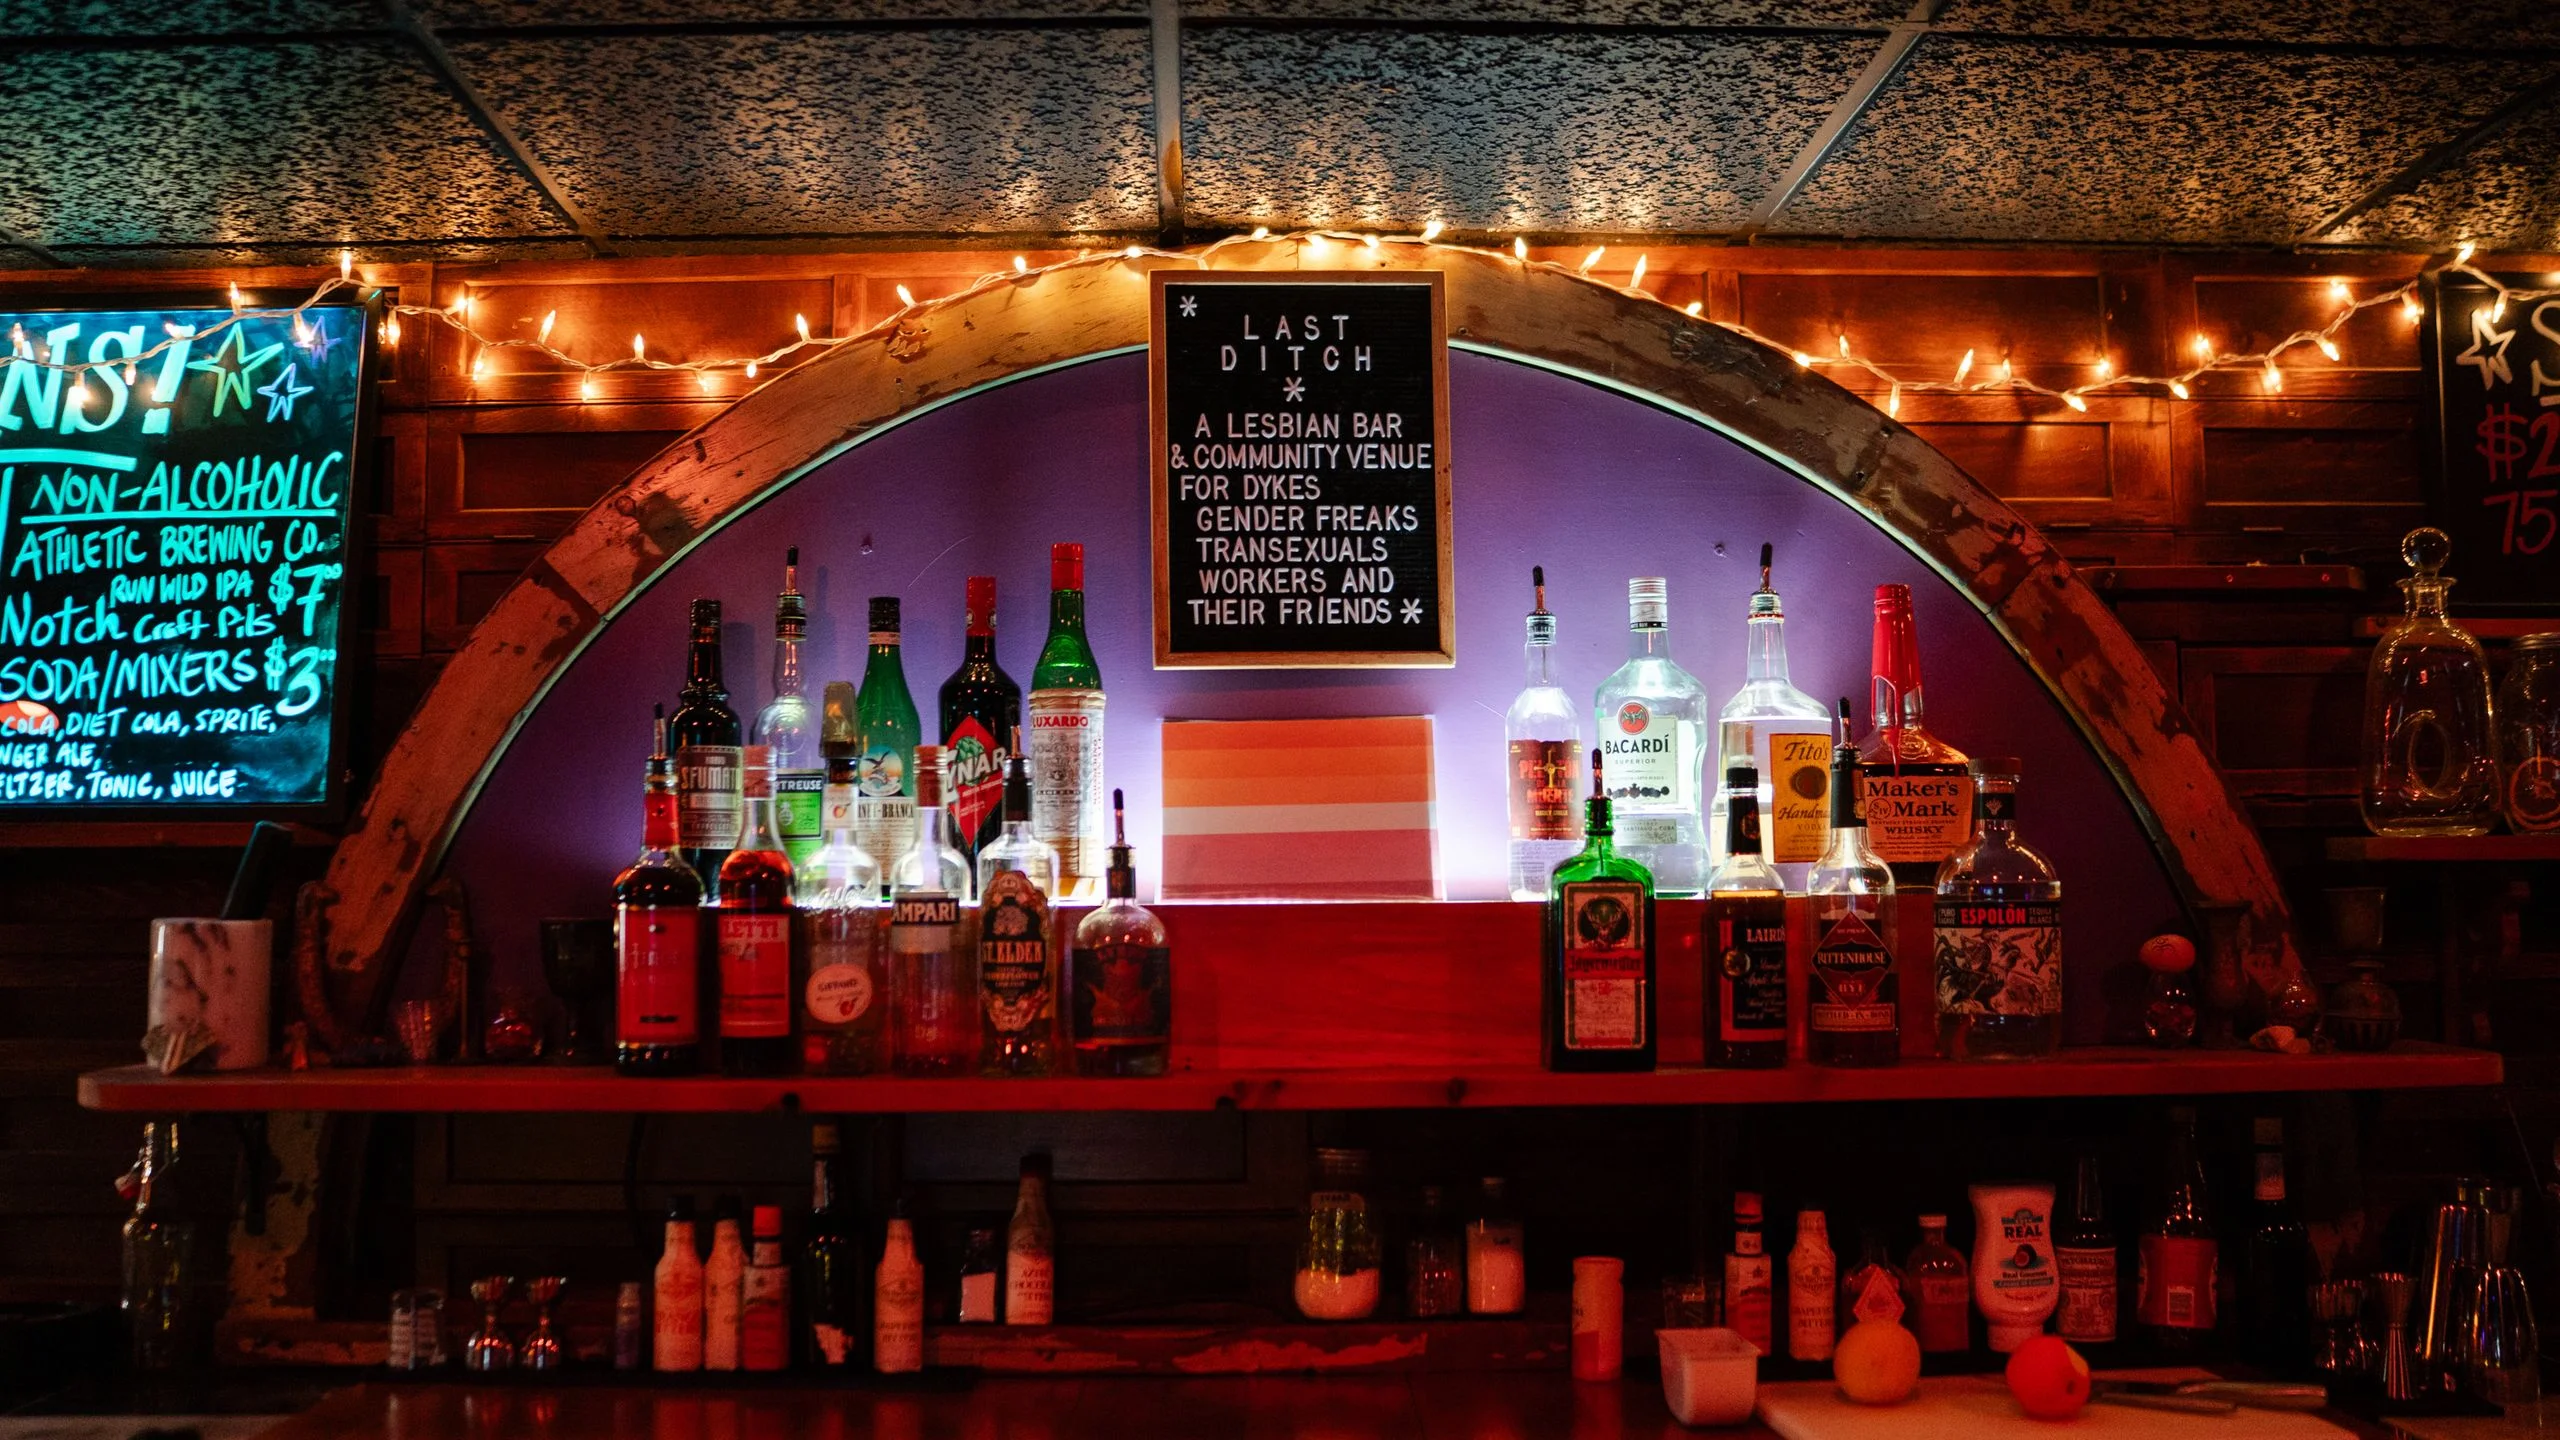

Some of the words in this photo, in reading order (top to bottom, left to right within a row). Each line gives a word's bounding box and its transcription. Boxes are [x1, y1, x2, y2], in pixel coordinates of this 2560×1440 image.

[1243, 314, 1349, 341] LAST
[1220, 344, 1371, 372] DITCH
[1194, 412, 1212, 439] A
[1227, 412, 1339, 439] LESBIAN
[1353, 411, 1402, 439] BAR
[1170, 443, 1189, 470] &
[1193, 443, 1340, 470] COMMUNITY
[1345, 443, 1432, 470] VENUE
[30, 451, 344, 515] NON-ALCOHOLIC
[1180, 474, 1229, 501] FOR
[1243, 474, 1321, 501] DYKES
[1196, 504, 1304, 533] GENDER
[1315, 504, 1419, 533] FREAKS
[2482, 489, 2559, 555] 75
[11, 525, 148, 581] ATHLETIC
[160, 522, 273, 567] BREWING
[283, 519, 324, 558] CO.
[1195, 536, 1389, 563] TRANSEXUALS
[109, 574, 155, 608] RUN
[160, 571, 208, 605] WILD
[215, 569, 254, 602] IPA
[1198, 567, 1327, 594] WORKERS
[1340, 566, 1395, 594] AND
[0, 591, 128, 647] Notch
[217, 603, 277, 639] Pils
[1187, 599, 1266, 625] THEIR
[1279, 596, 1393, 625] FRIENDS
[195, 704, 277, 735] SPRITE,
[1033, 715, 1088, 728] LUXARDO
[55, 741, 101, 772] ALE,
[1605, 734, 1669, 754] BACARDÍ
[1783, 740, 1828, 761] Tito's
[85, 770, 163, 800] TONIC,
[171, 766, 238, 798] JUICE
[945, 746, 1008, 793] YNAR
[1867, 780, 1958, 797] Maker's
[1893, 801, 1957, 817] Mark
[1883, 825, 1944, 834] WHISKY
[892, 900, 957, 923] AMPARI
[1959, 903, 2027, 925] ESPOLÓN
[1817, 951, 1887, 965] RITTENHOUSE
[2004, 1225, 2043, 1239] REAL
